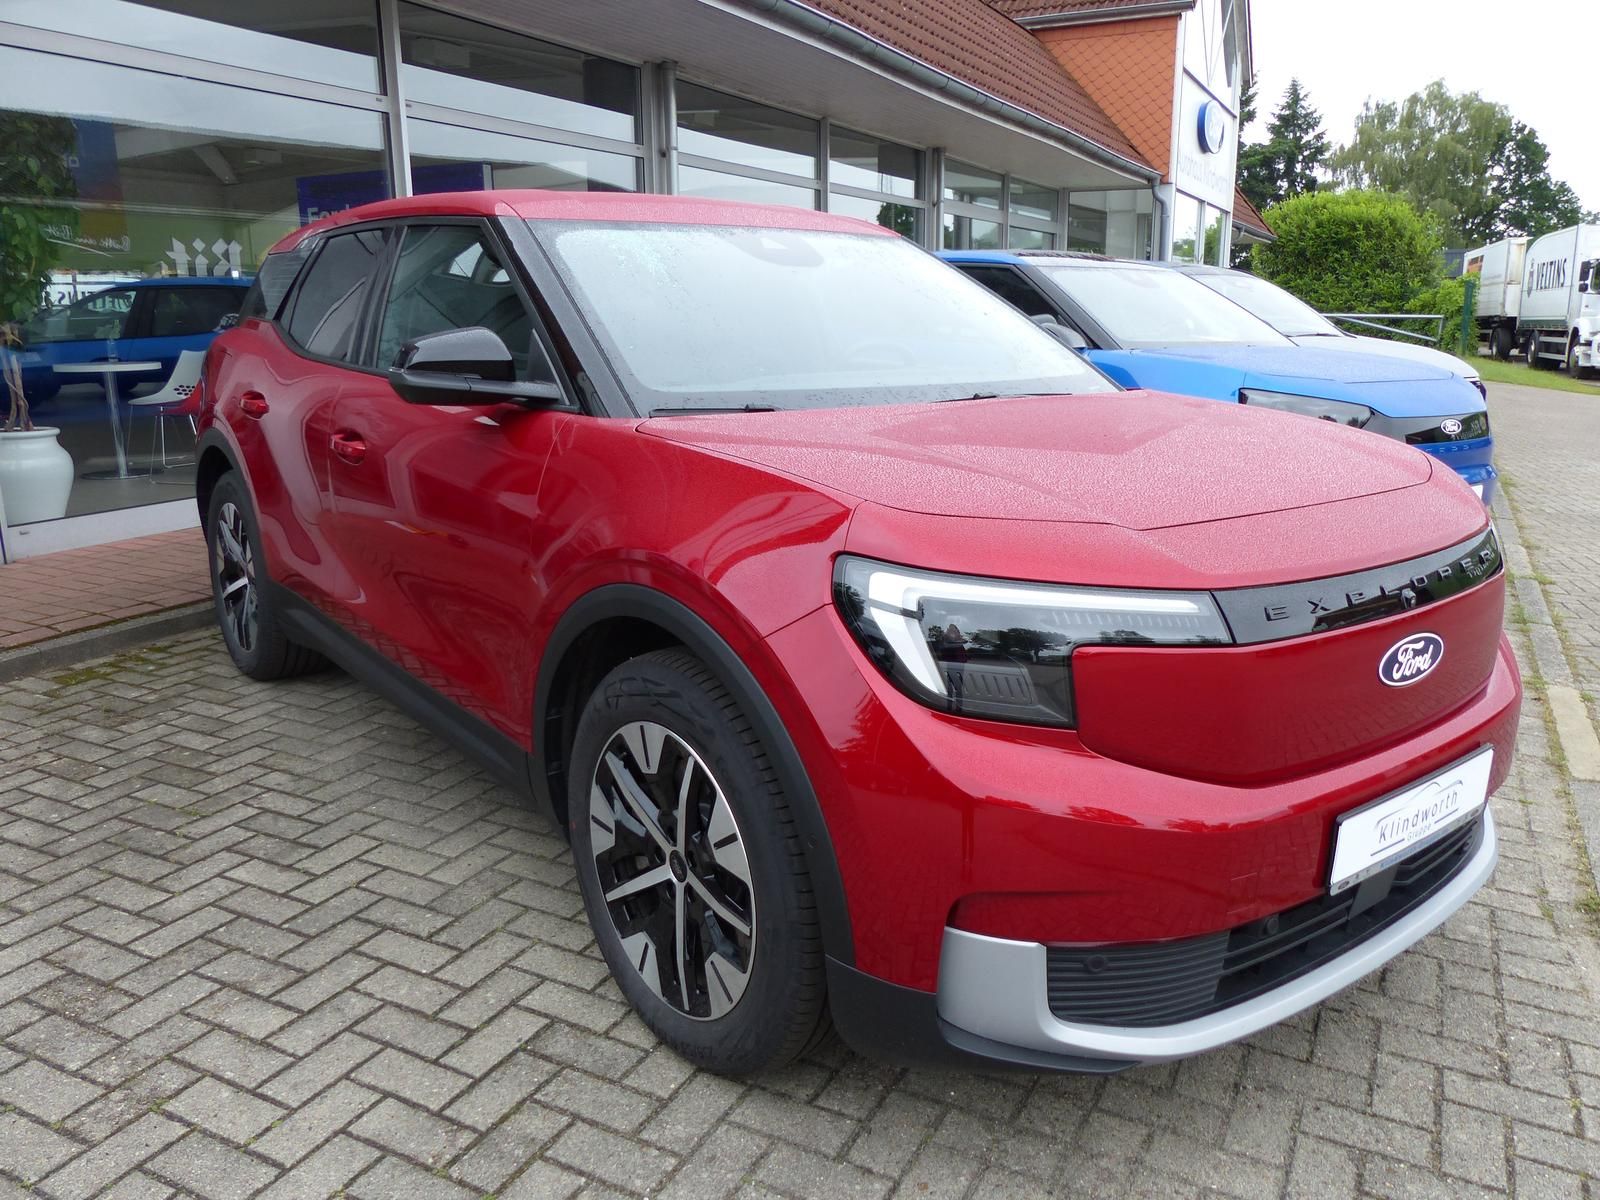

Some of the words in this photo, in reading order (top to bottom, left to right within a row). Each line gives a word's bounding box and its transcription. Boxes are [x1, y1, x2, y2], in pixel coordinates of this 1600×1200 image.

[1536, 257, 1567, 290] VELTINS
[1263, 550, 1496, 622] EXPLORER
[1392, 639, 1434, 680] Ford
[1378, 790, 1458, 844] Klindworth
